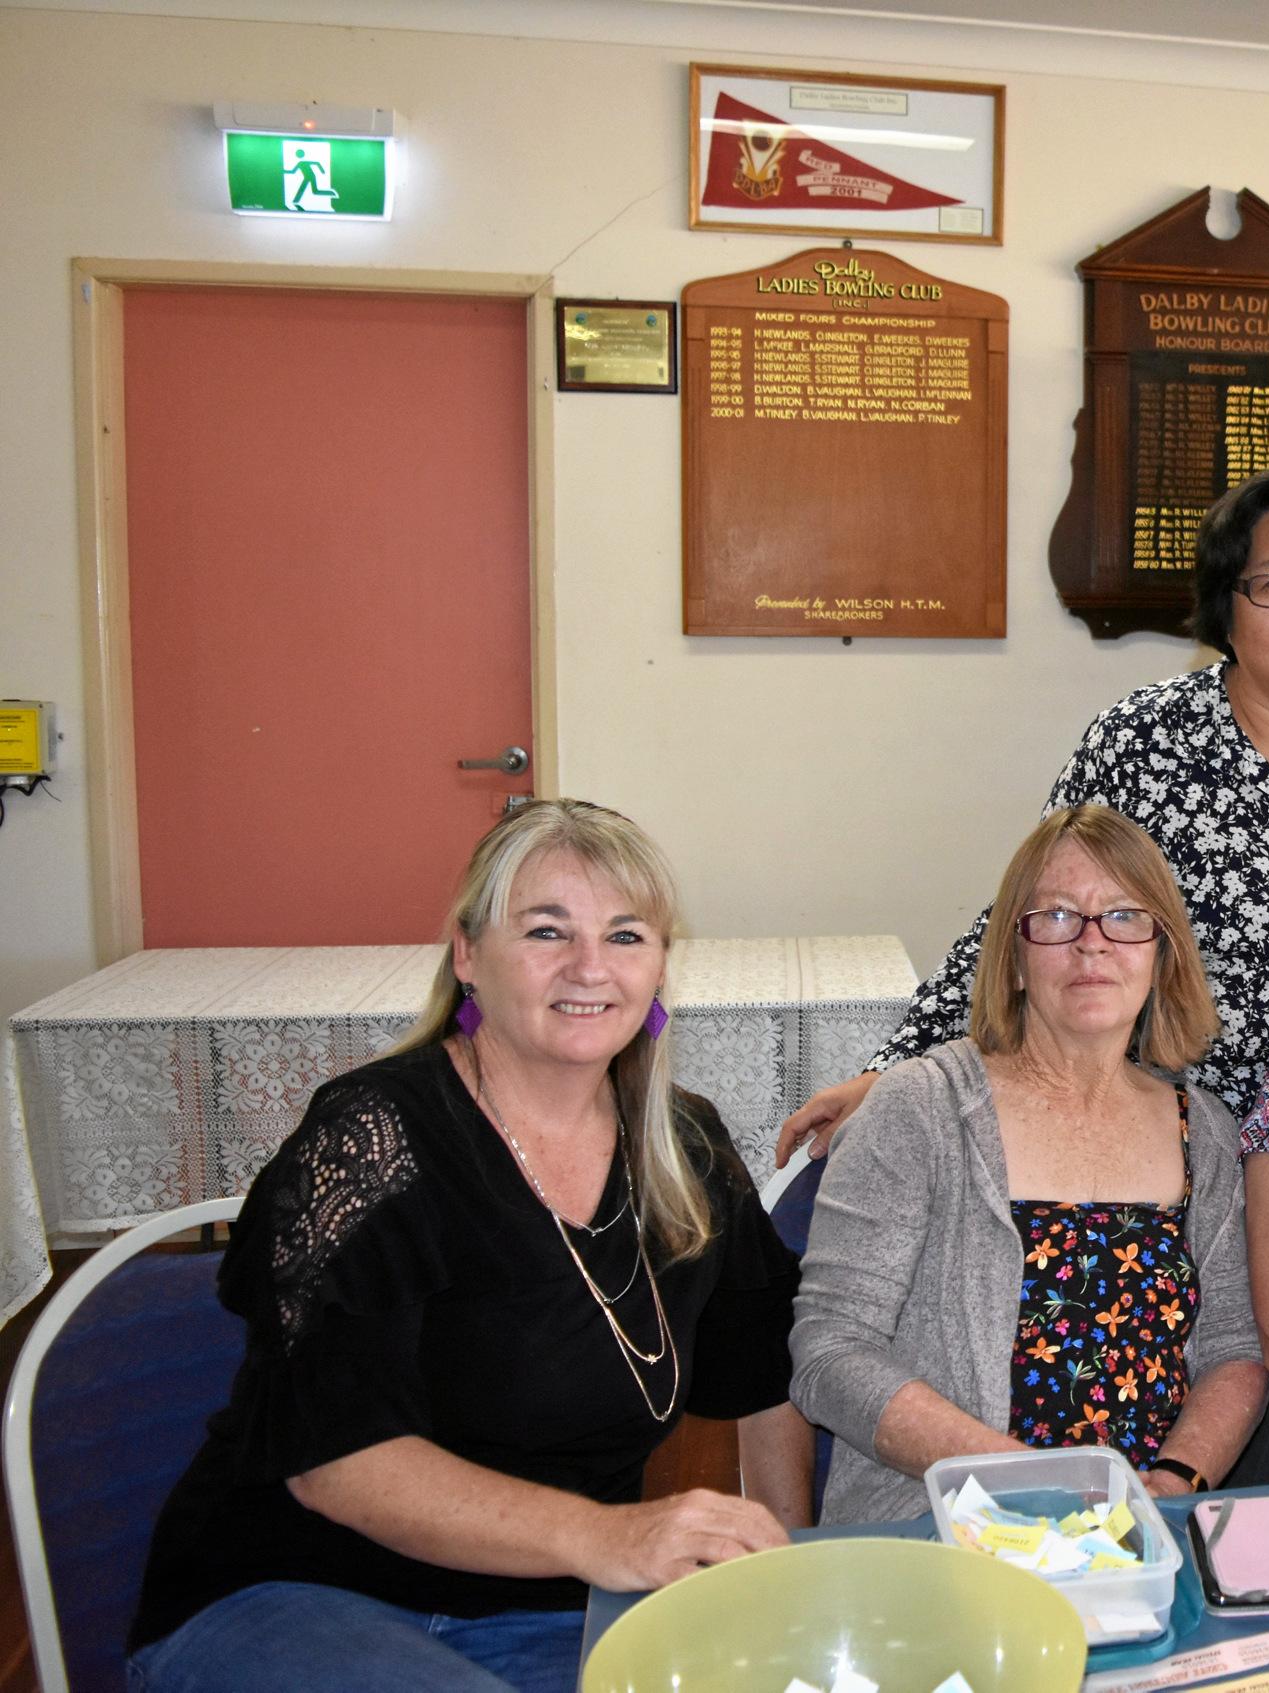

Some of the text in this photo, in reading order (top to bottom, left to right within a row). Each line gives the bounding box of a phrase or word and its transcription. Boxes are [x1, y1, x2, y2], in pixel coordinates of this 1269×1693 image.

[805, 154, 834, 170] RED
[812, 176, 878, 189] PENNANT
[830, 187, 863, 197] 2001
[814, 259, 875, 281] Dalby
[758, 277, 943, 301] LADIES BOWLING CLUB
[1140, 293, 1212, 312] DALBY
[755, 313, 936, 329] MIXED FOURS CHAMPIONSHIP
[1150, 314, 1240, 333] BOWLING
[1156, 335, 1215, 350] HONOUR
[1189, 363, 1246, 375] PRESIDENTS
[754, 594, 810, 610] Presented
[812, 597, 826, 612] by
[835, 599, 894, 609] WILSON
[804, 611, 883, 621] SHAREBROKERS
